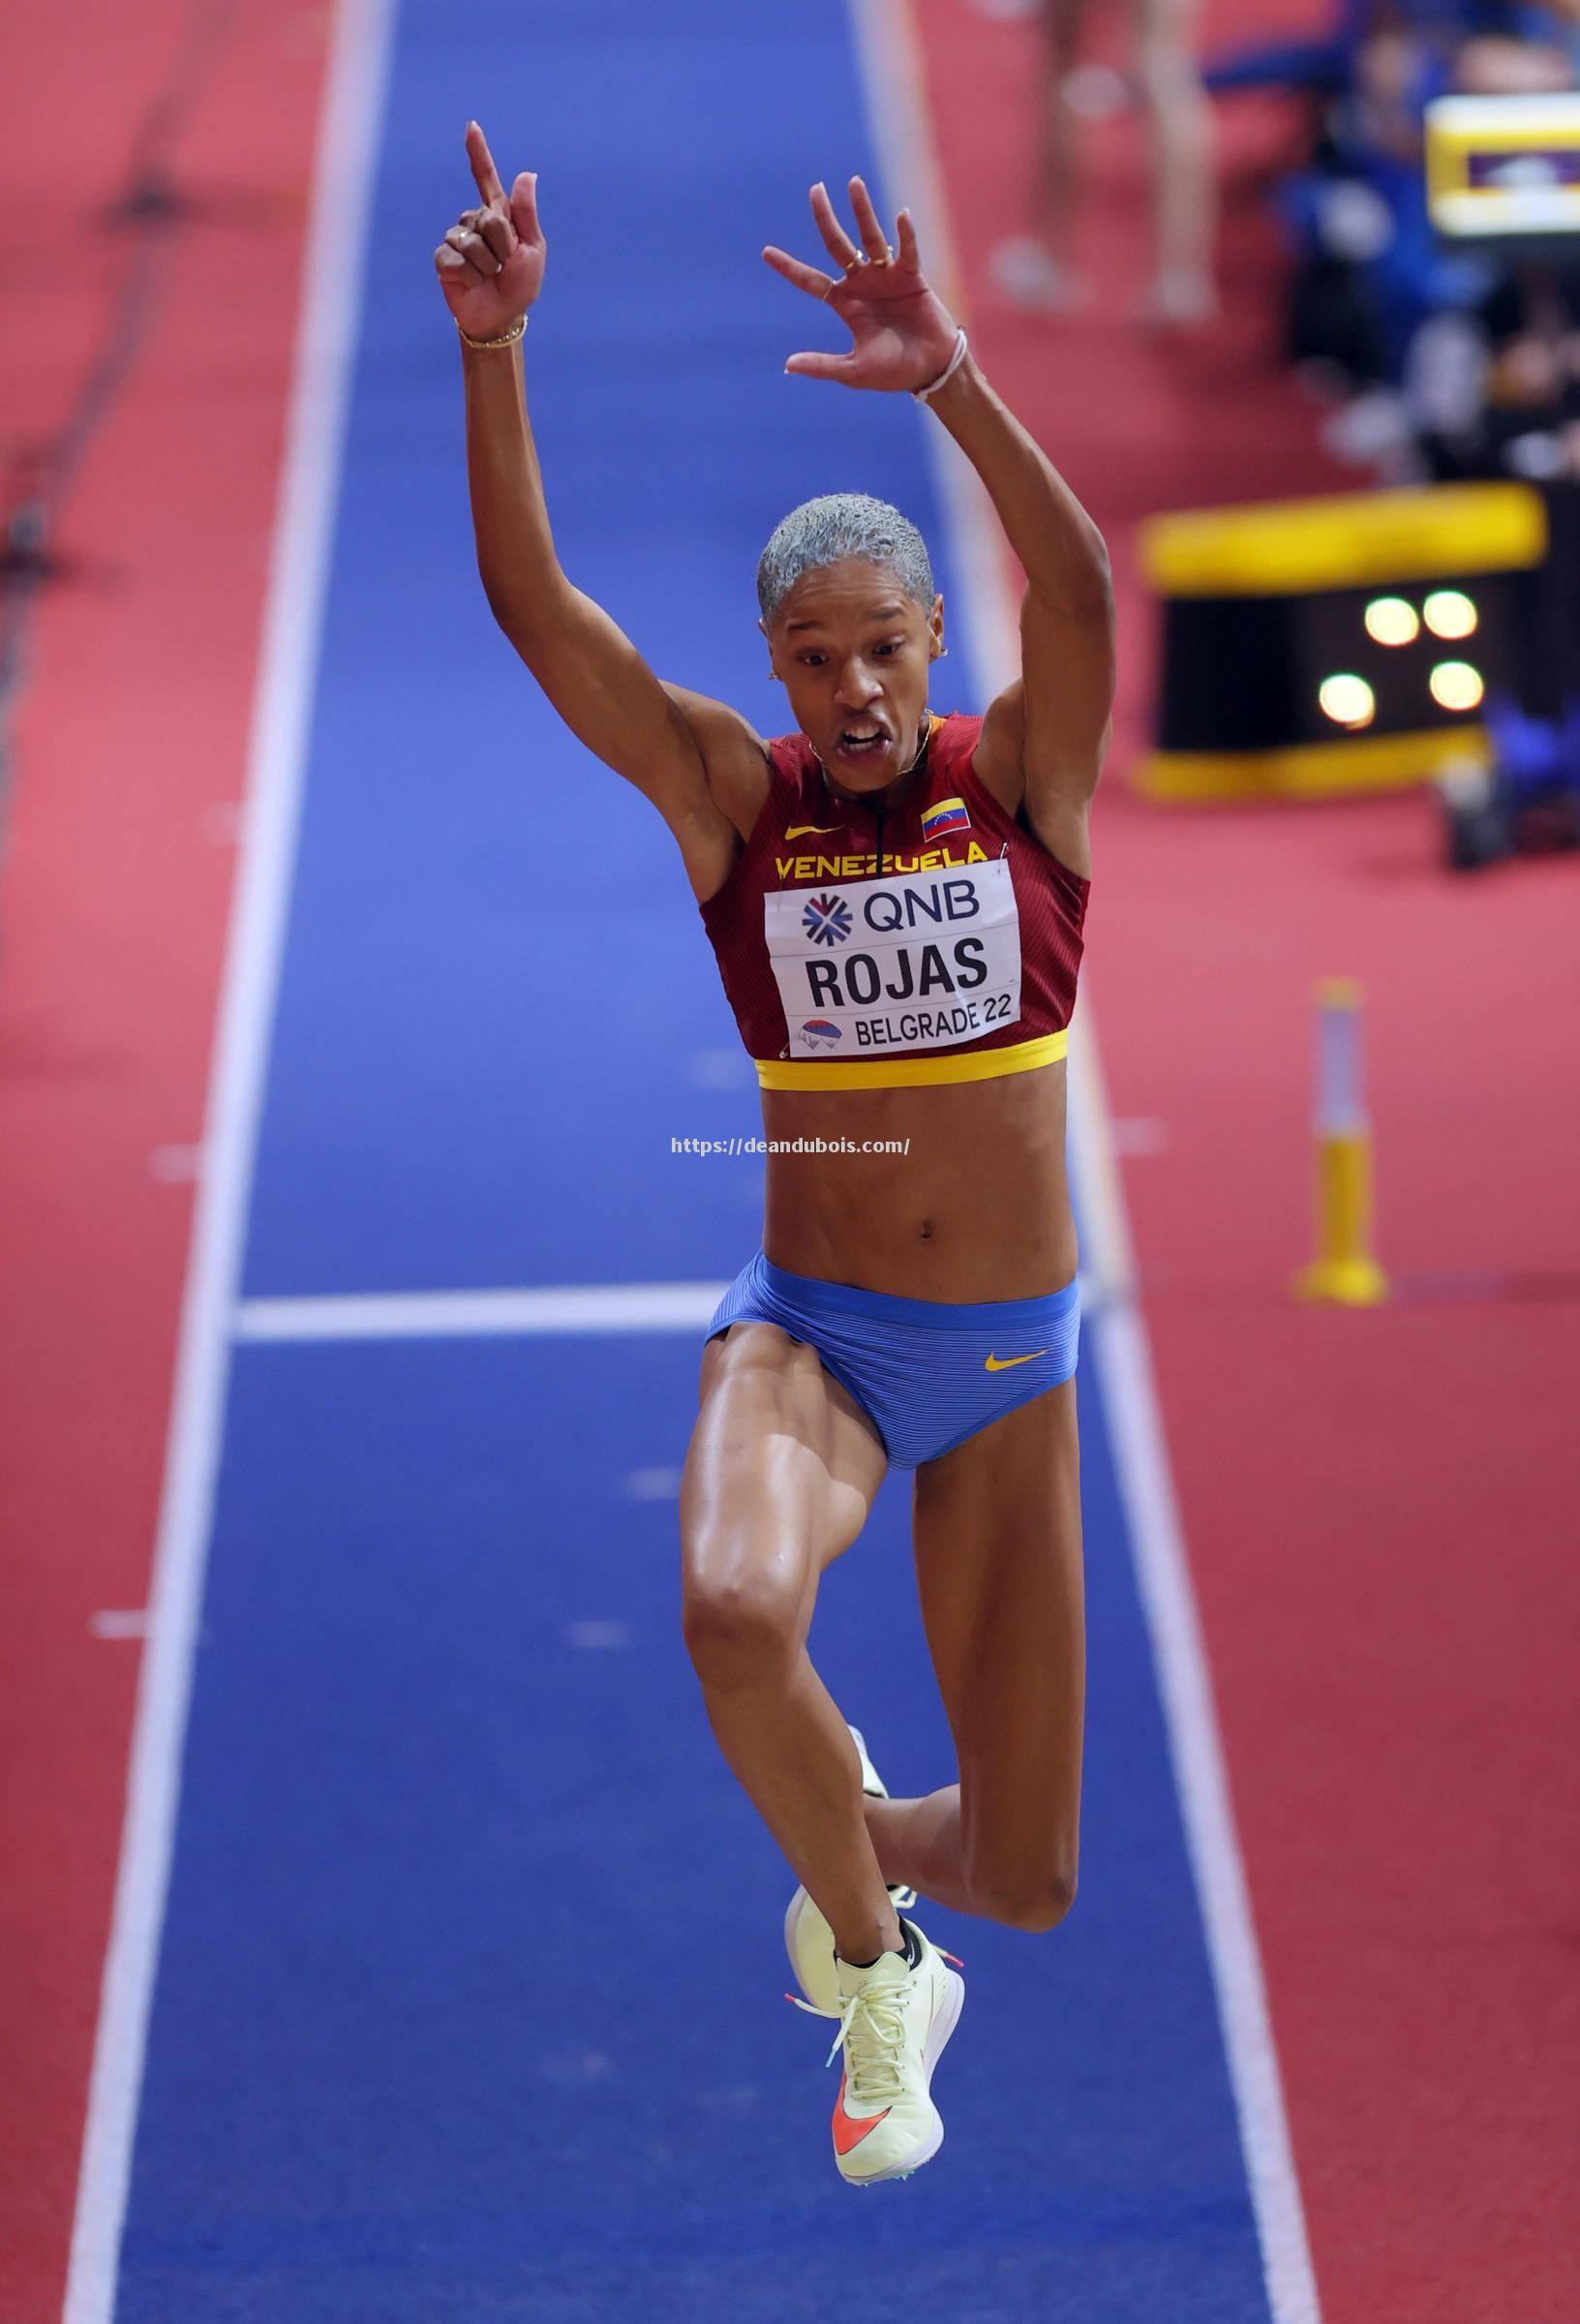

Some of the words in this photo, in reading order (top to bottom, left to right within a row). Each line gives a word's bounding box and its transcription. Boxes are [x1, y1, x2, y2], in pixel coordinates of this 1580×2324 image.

[775, 841, 988, 880] VENEZUELA
[864, 879, 980, 933] QNB
[805, 937, 988, 1008] ROJAS
[855, 1001, 980, 1046] BELGRADE
[984, 994, 1012, 1023] 22
